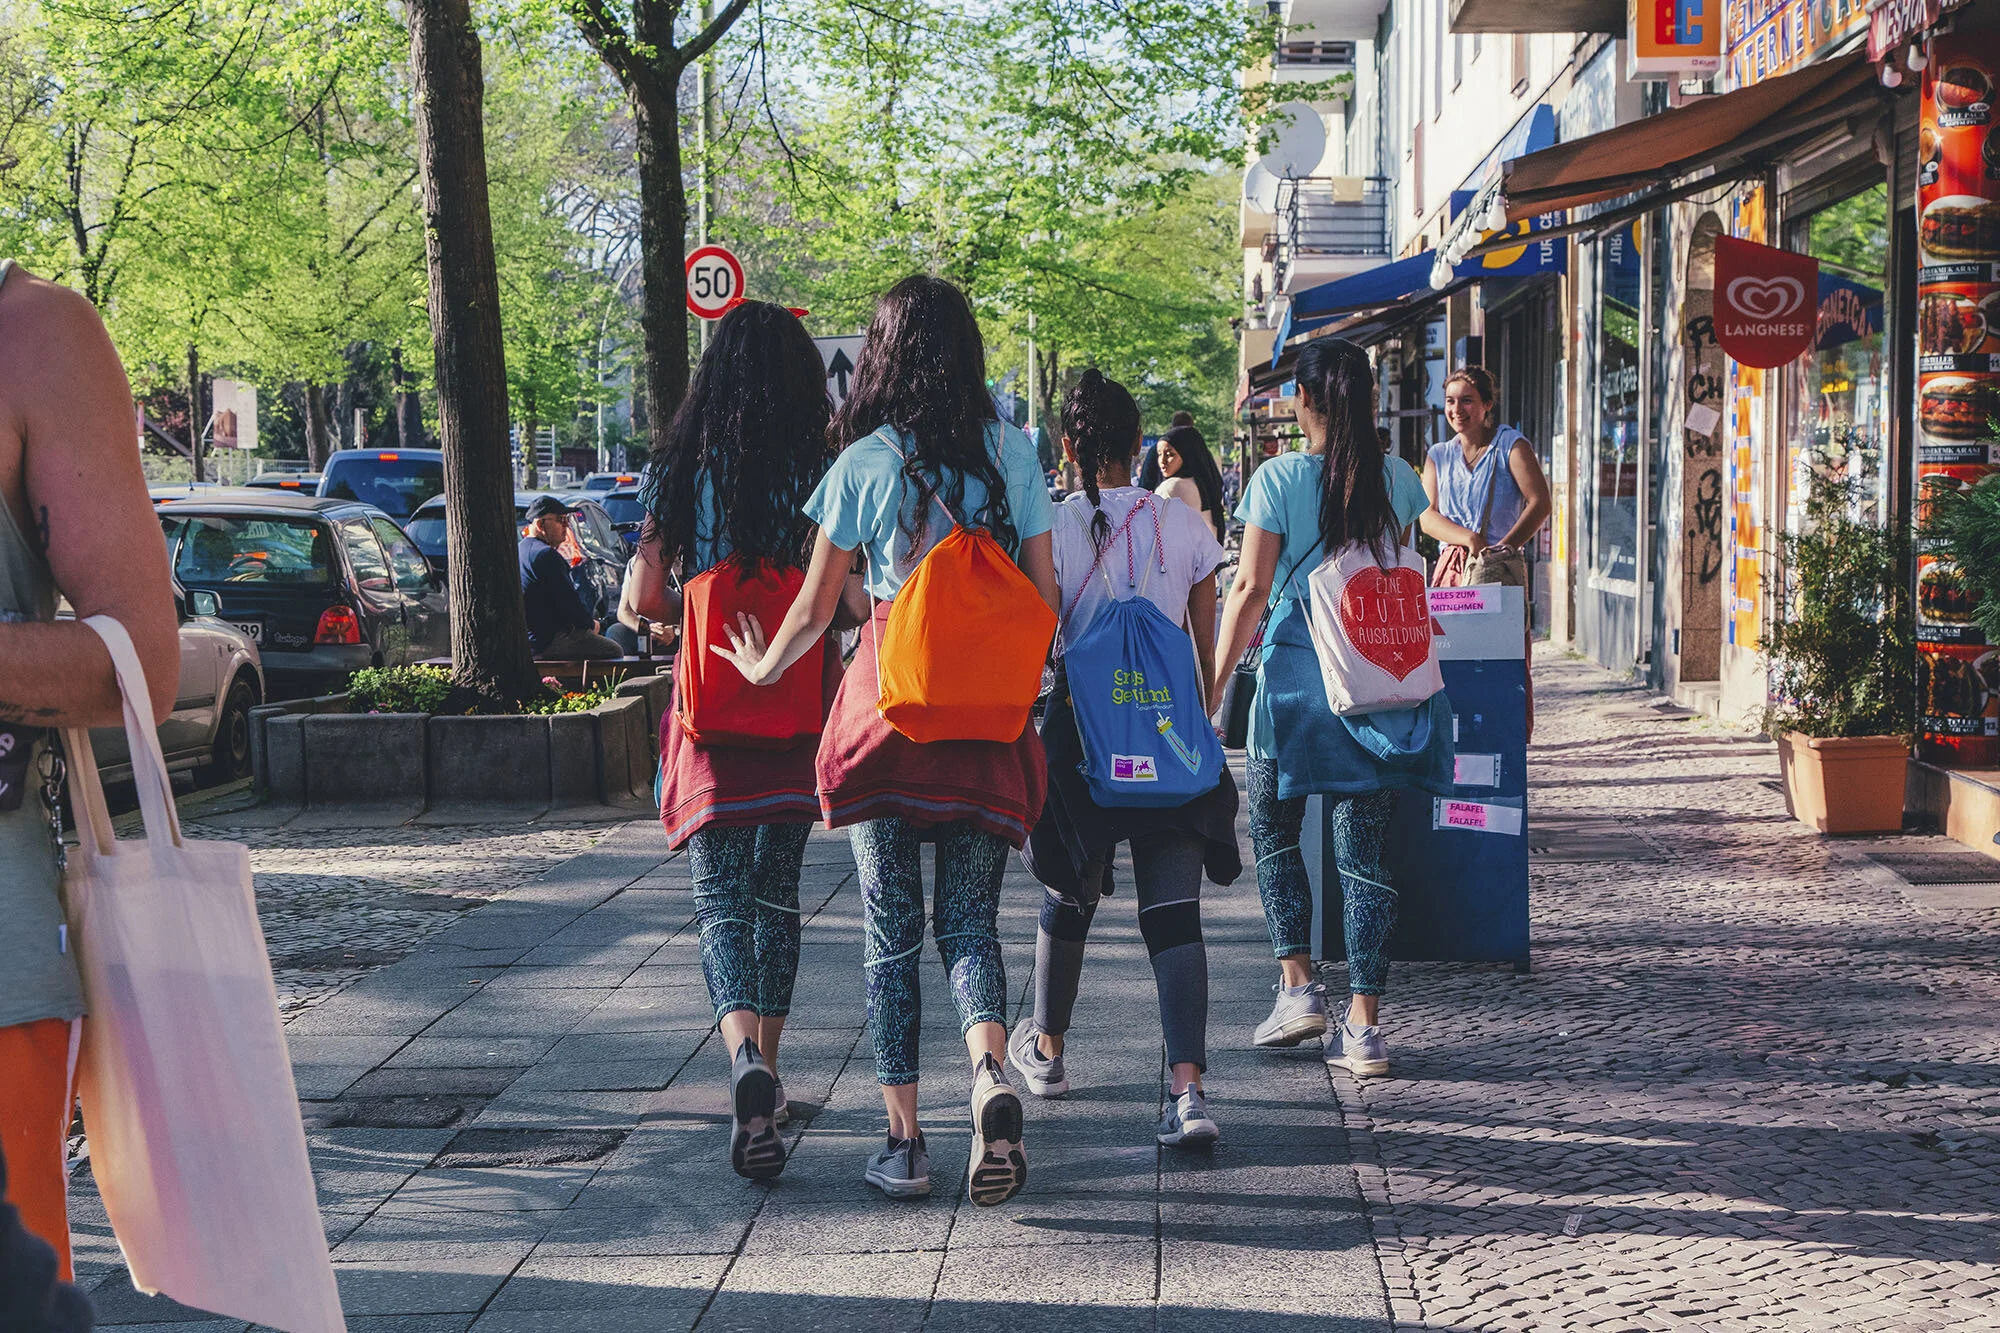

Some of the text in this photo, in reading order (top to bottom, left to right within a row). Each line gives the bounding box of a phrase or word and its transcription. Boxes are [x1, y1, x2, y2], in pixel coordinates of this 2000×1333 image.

[695, 266, 730, 298] 50
[1725, 323, 1804, 336] LANGNESE
[1376, 577, 1402, 593] EINE
[1430, 591, 1476, 600] ALLES ZUM
[1431, 603, 1484, 612] MITNEHMEN
[232, 623, 260, 640] 89
[1450, 803, 1485, 814] FALAFEL
[1449, 816, 1485, 828] FALAFEL
